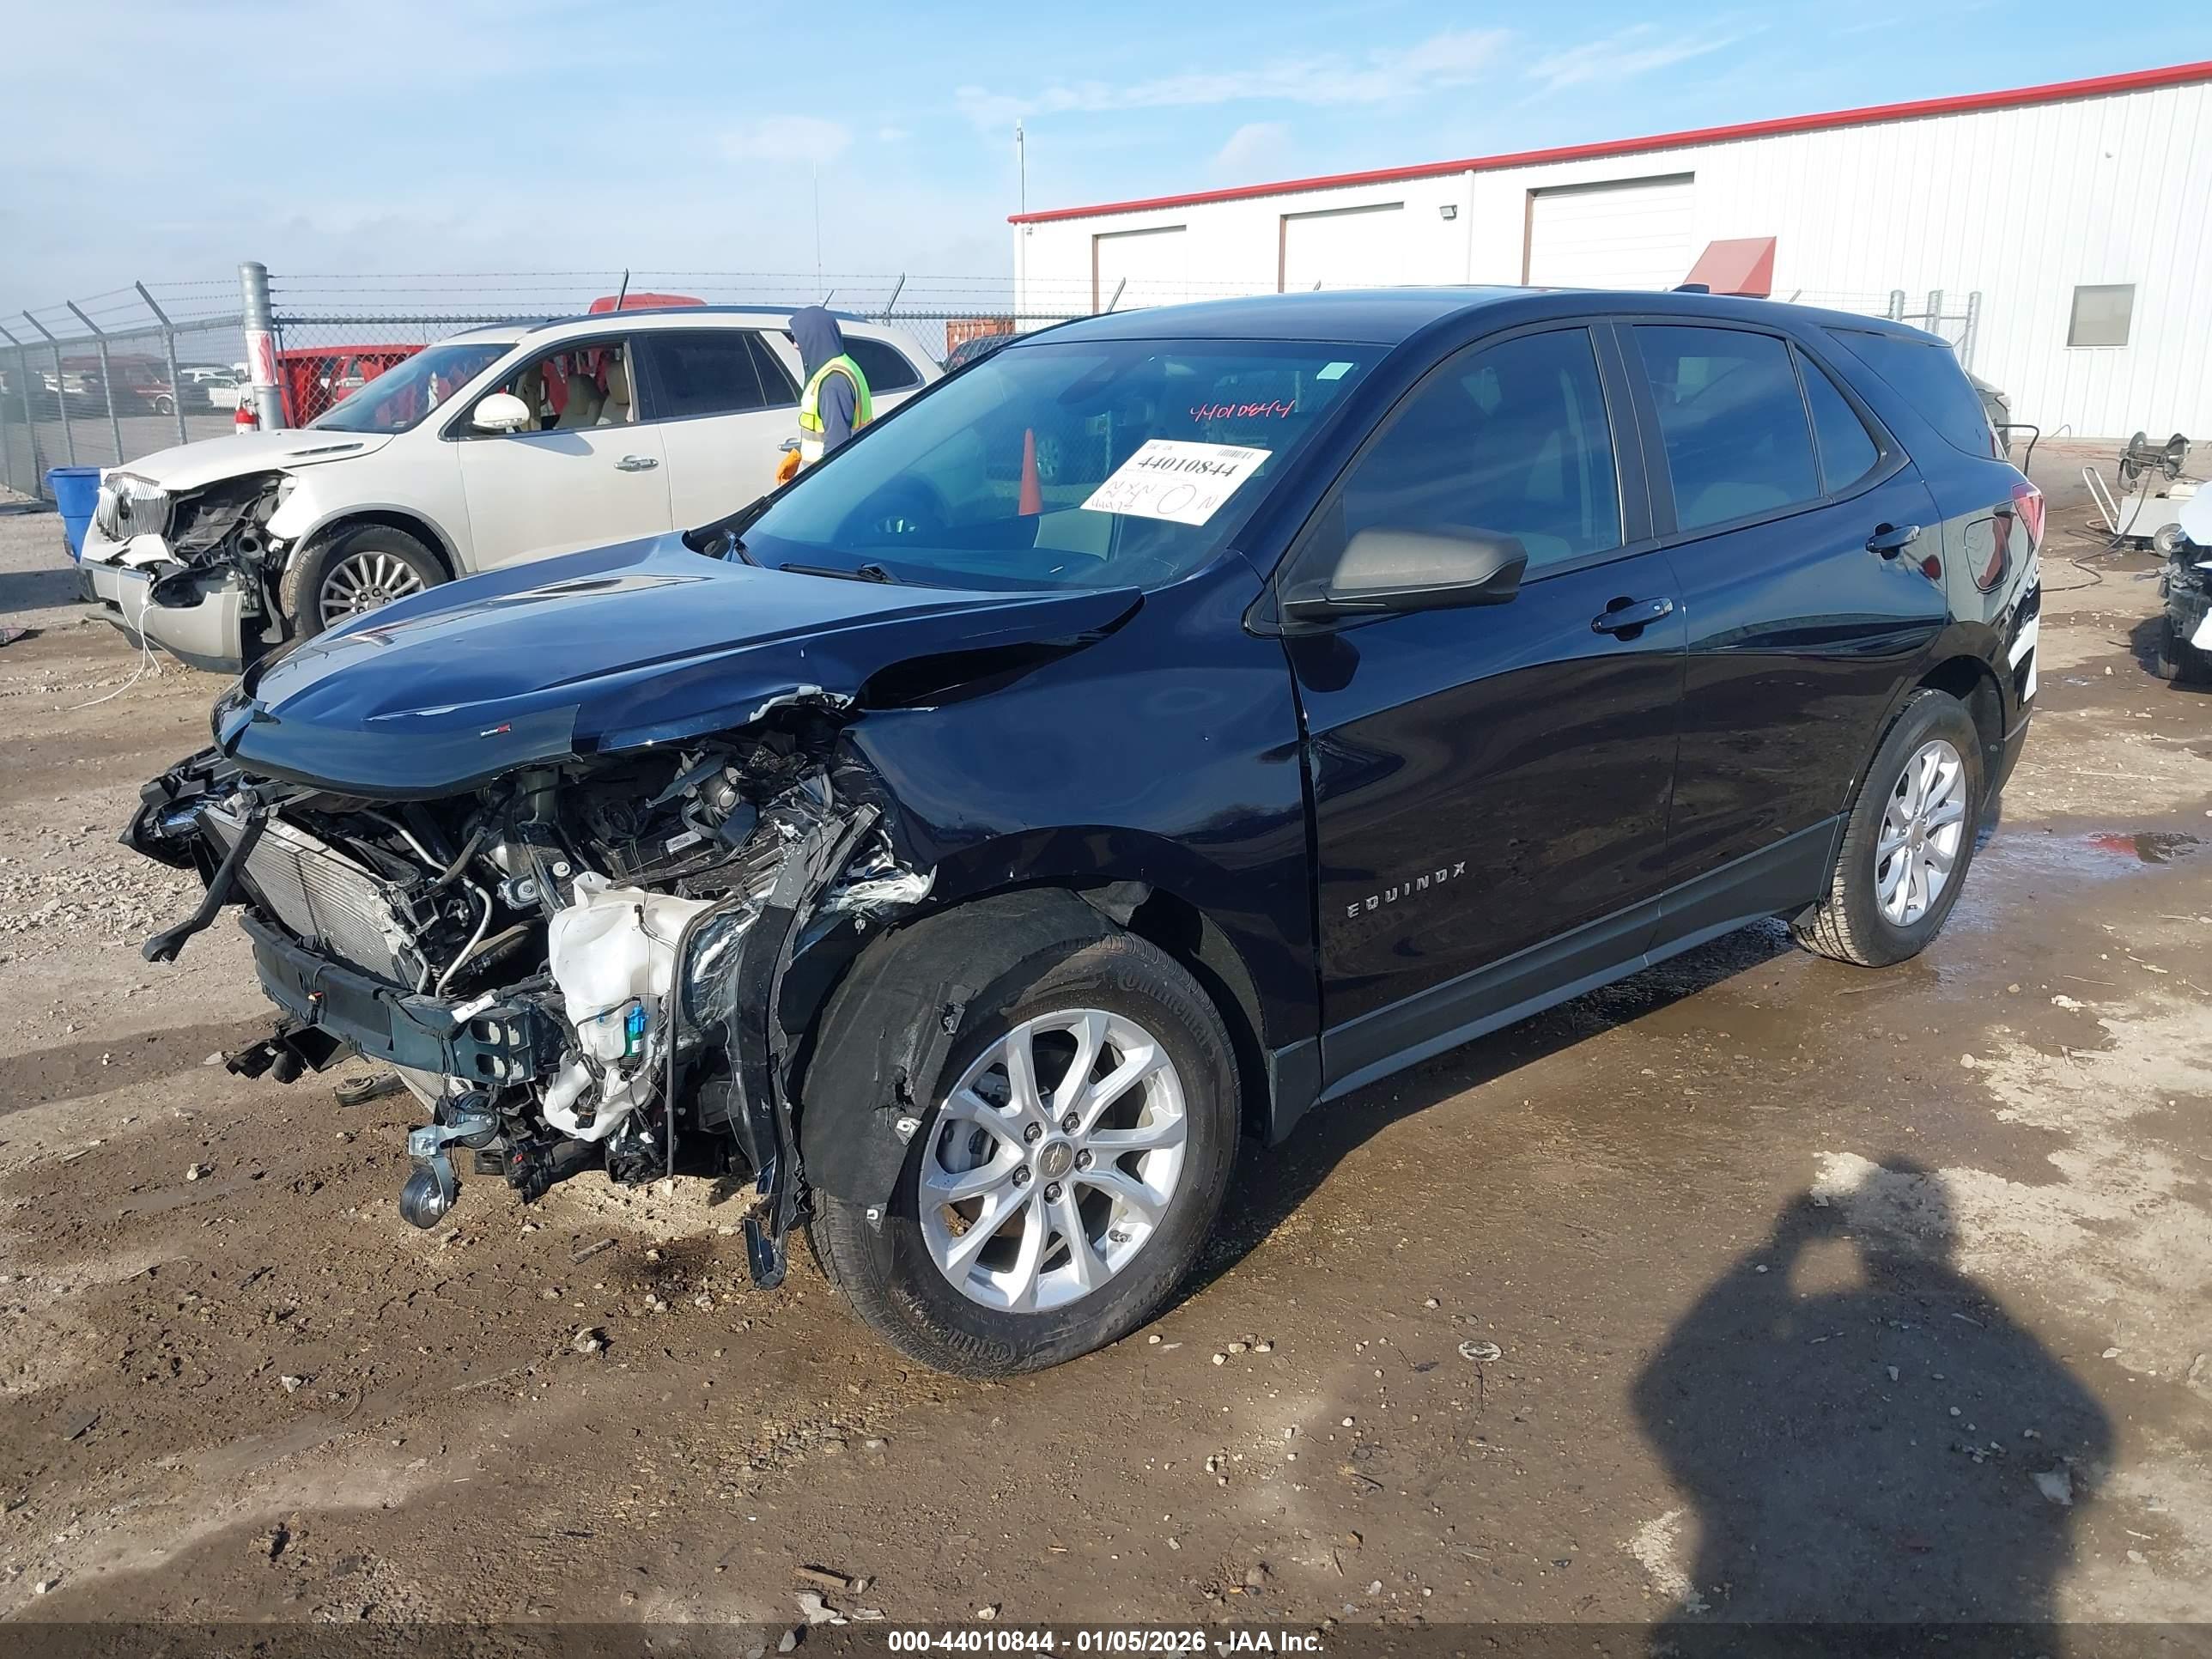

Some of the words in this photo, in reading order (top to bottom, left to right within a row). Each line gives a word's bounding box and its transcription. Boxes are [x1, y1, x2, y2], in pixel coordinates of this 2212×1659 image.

[1189, 399, 1296, 423] 44010844
[1138, 455, 1239, 477] 44010844
[1346, 860, 1466, 919] EQUINOX
